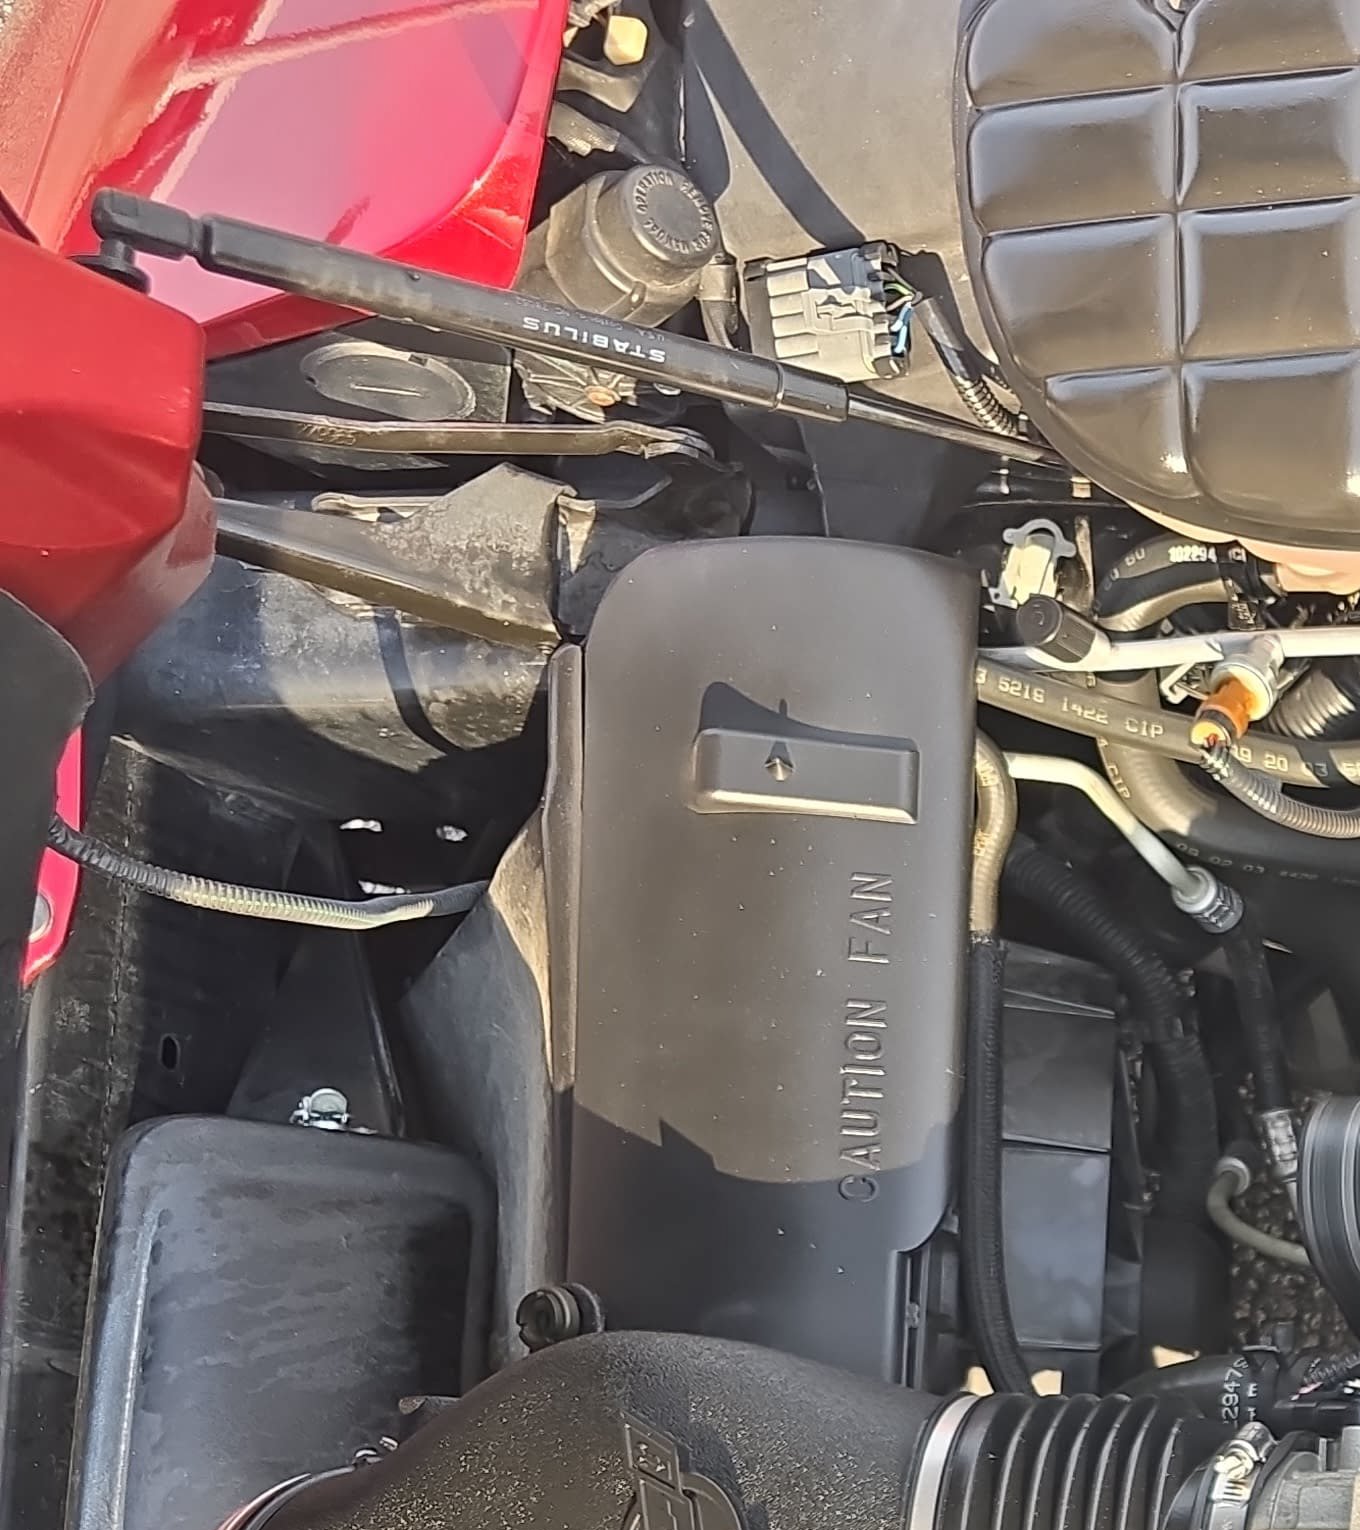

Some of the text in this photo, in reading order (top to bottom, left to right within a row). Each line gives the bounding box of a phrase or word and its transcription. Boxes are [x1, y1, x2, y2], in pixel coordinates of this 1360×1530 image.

[522, 316, 666, 363] STABILUS
[1061, 697, 1110, 725] 1422
[1264, 753, 1290, 772] 20
[838, 870, 894, 1202] CAUTION FAN
